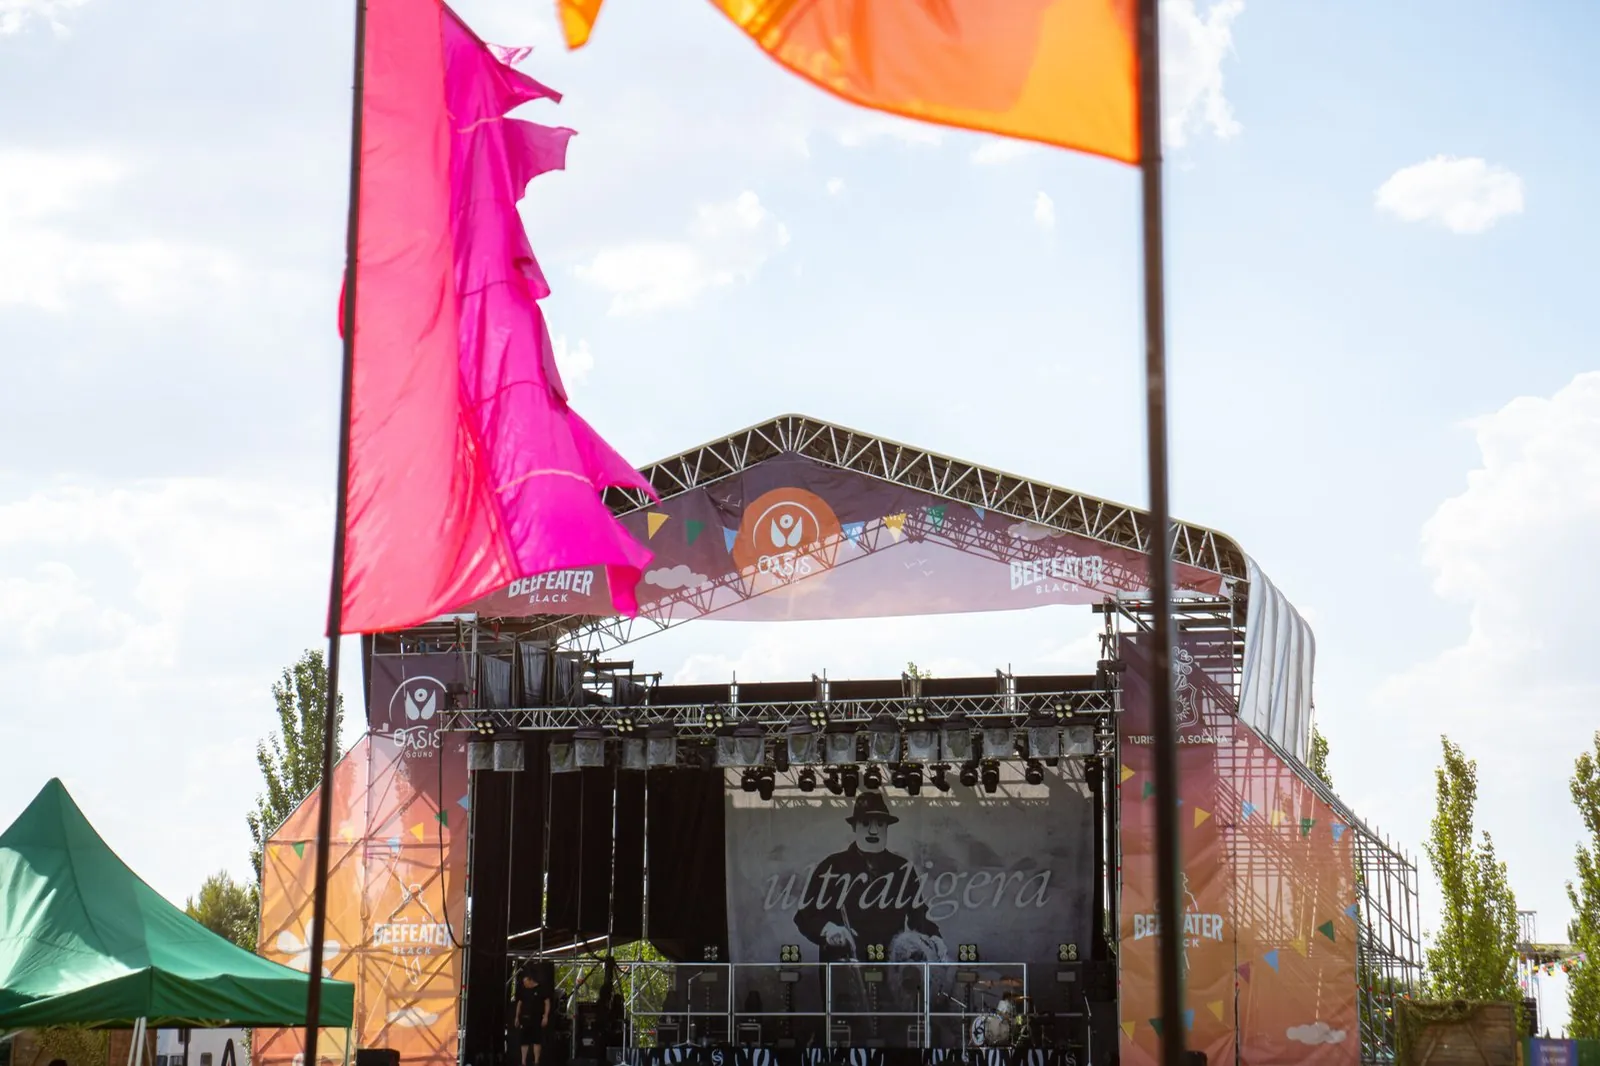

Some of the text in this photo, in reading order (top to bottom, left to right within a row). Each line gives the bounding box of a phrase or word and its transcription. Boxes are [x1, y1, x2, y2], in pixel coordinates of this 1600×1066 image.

[757, 549, 812, 575] OASIS
[1010, 555, 1103, 590] BEEFEATER
[508, 570, 594, 599] BEEFEATER
[1036, 583, 1079, 594] BLACK
[529, 593, 568, 604] BLACK
[394, 724, 443, 750] OASIS
[1128, 735, 1157, 744] TURIS
[1187, 734, 1228, 745] SOLANA
[405, 751, 433, 759] SOUND
[763, 860, 1052, 922] ultraligera
[373, 923, 454, 949] BEEFEATER
[393, 946, 431, 956] BLACK
